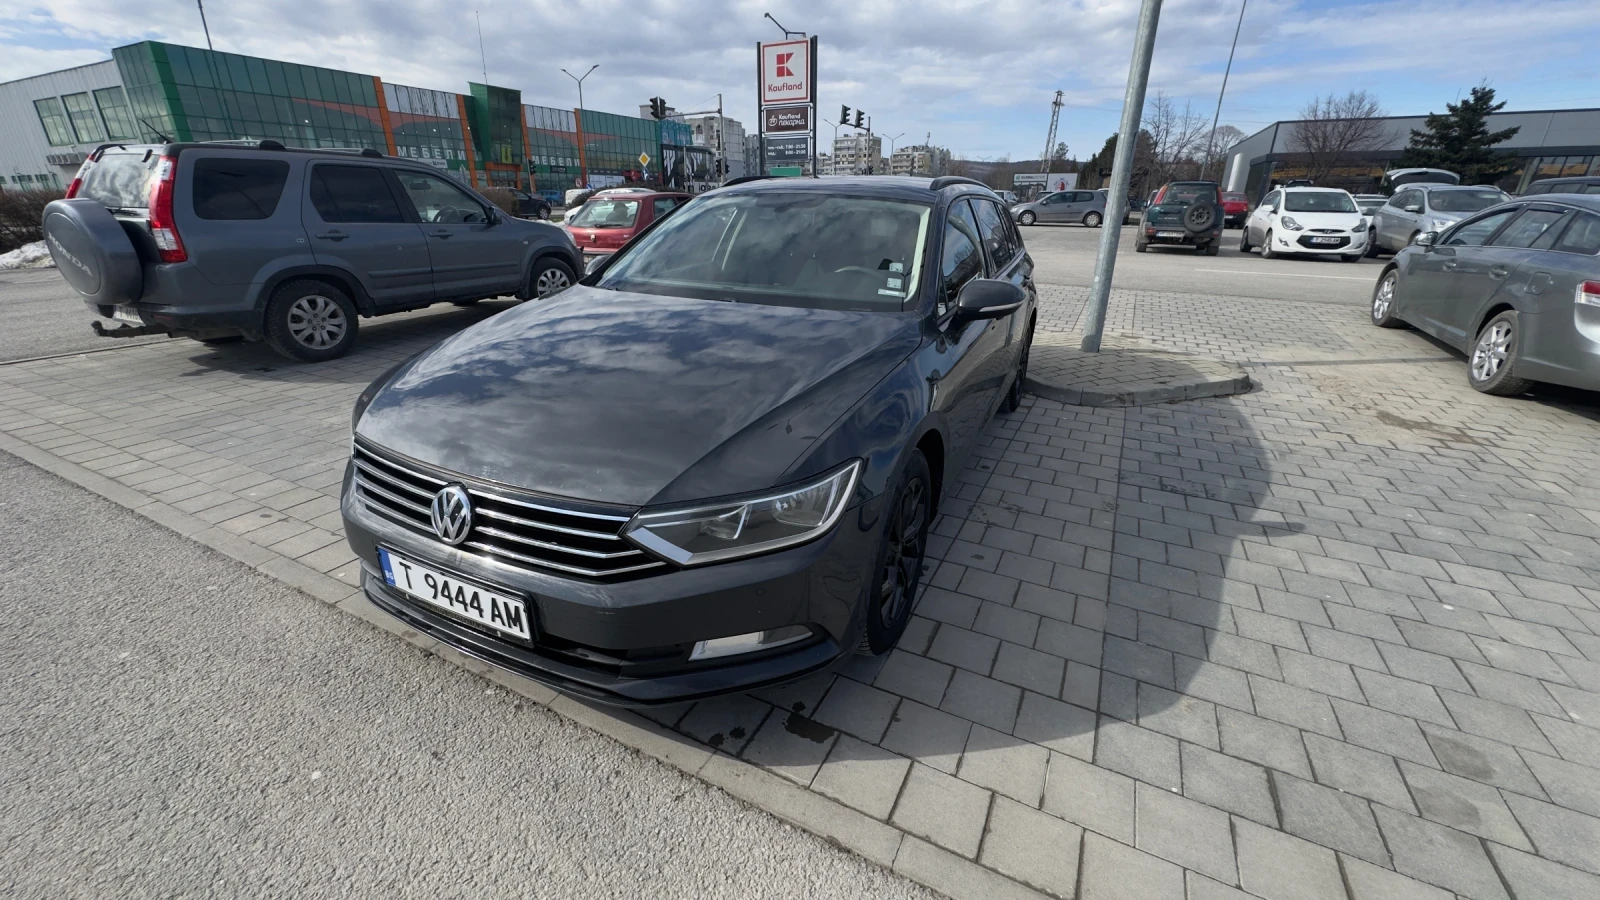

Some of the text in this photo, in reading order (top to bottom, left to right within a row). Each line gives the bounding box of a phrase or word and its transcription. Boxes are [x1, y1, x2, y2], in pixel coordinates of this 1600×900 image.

[768, 82, 802, 92] Kaufland
[396, 145, 467, 161] МЕБЕЛИ
[532, 155, 581, 167] МЕБЕЛИ
[48, 230, 94, 277] HONDA
[399, 561, 412, 589] T
[424, 573, 484, 618] 9444
[491, 597, 524, 633] AM
